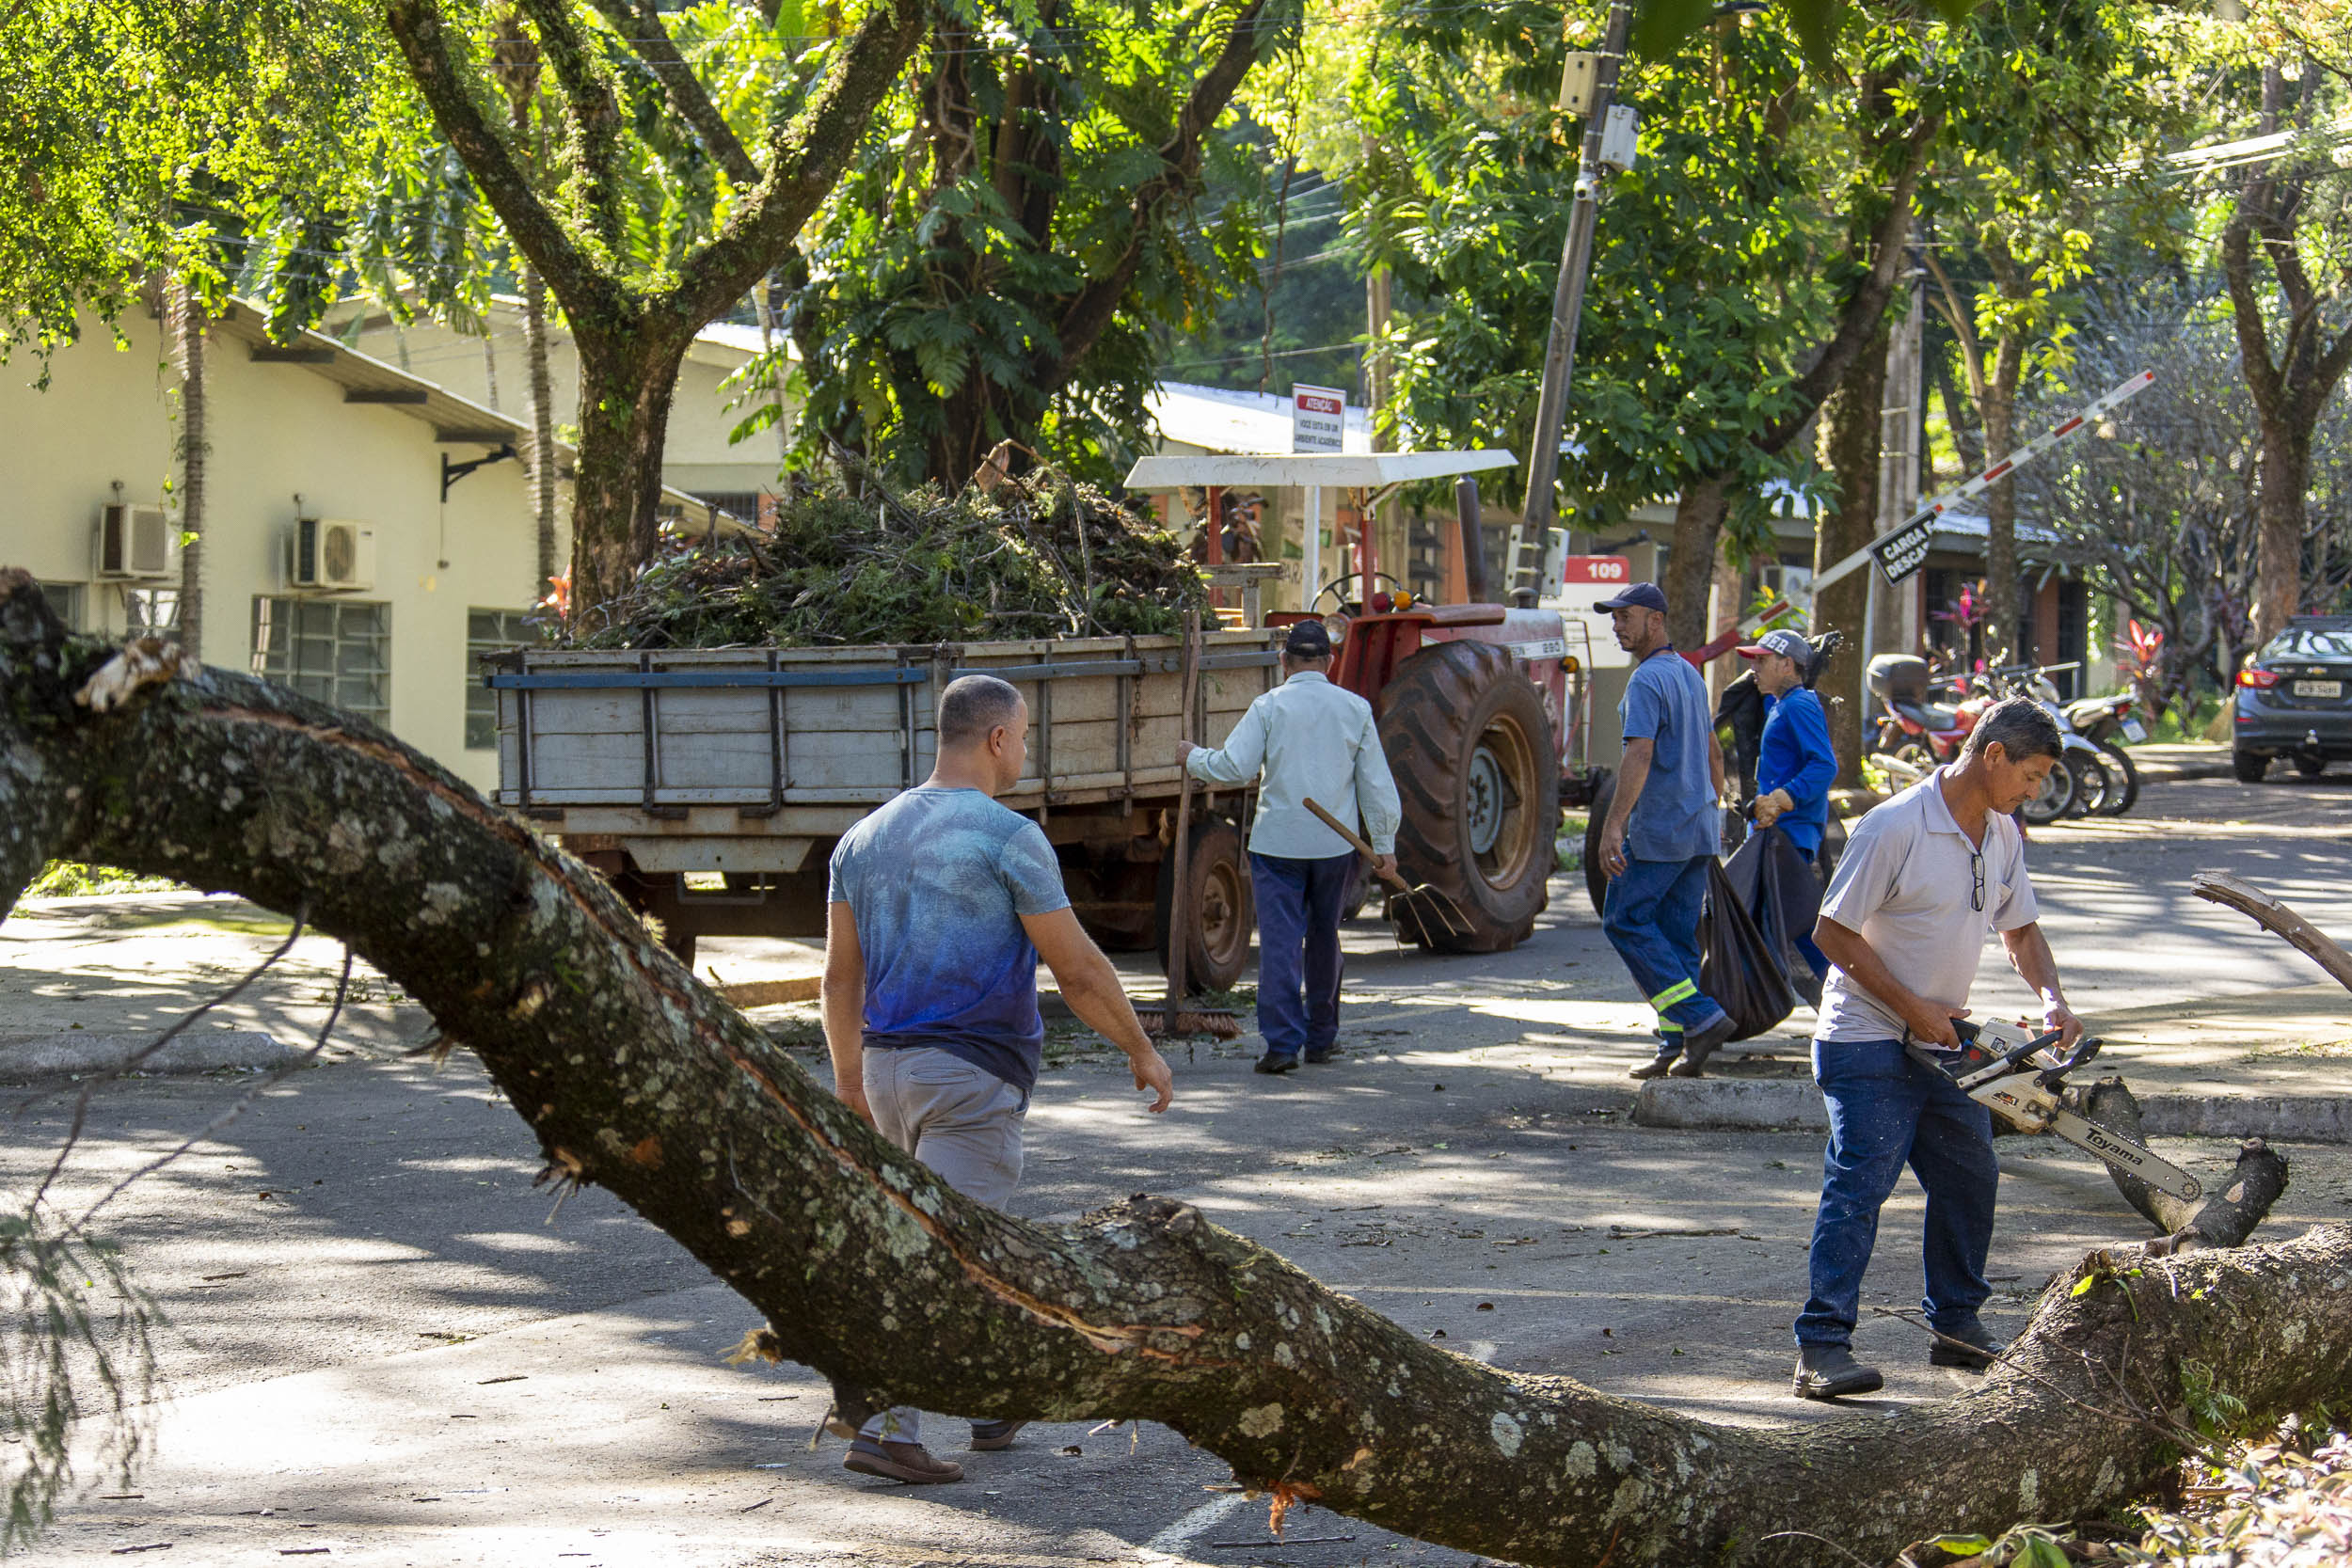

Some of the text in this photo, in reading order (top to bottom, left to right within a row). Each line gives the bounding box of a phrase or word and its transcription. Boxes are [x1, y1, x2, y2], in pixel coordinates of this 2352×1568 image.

[1883, 527, 1928, 561] CARGA
[1587, 562, 1623, 579] 109
[2084, 1127, 2144, 1166] Toyama
